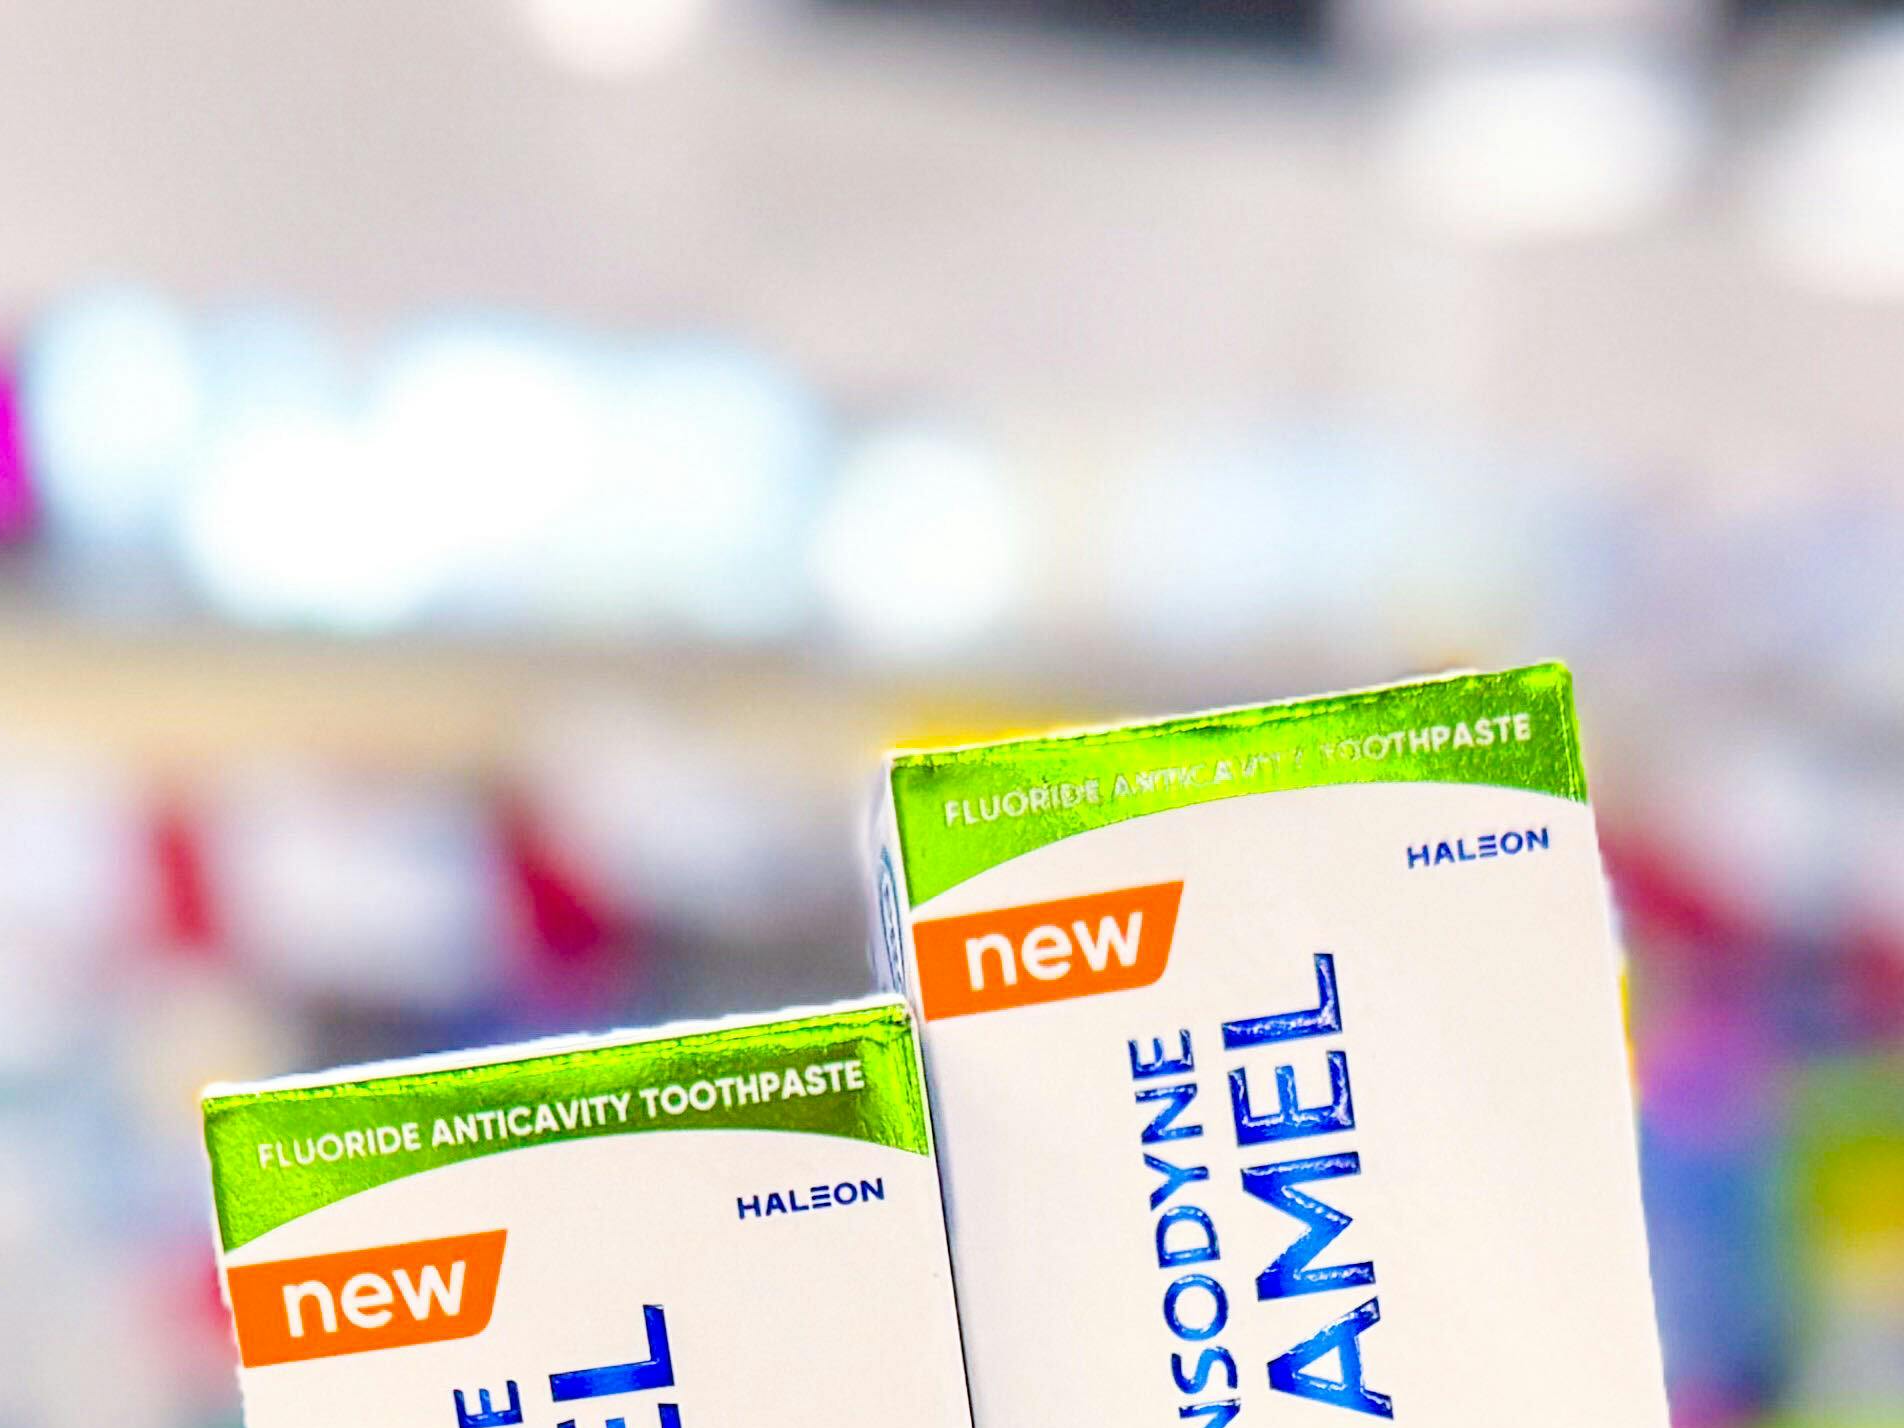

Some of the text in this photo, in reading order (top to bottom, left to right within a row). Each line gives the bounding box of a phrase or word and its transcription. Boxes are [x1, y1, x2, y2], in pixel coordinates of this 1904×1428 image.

[944, 780, 1101, 828] FLUORIDE
[1319, 711, 1532, 761] TOOTHPASTE
[1406, 827, 1550, 870] HALEON
[965, 911, 1144, 991] new
[257, 1060, 866, 1170] FLUORIDE ANTICAVITY TOOTHPASTE
[736, 1178, 886, 1220] HALEON
[282, 1260, 467, 1338] new
